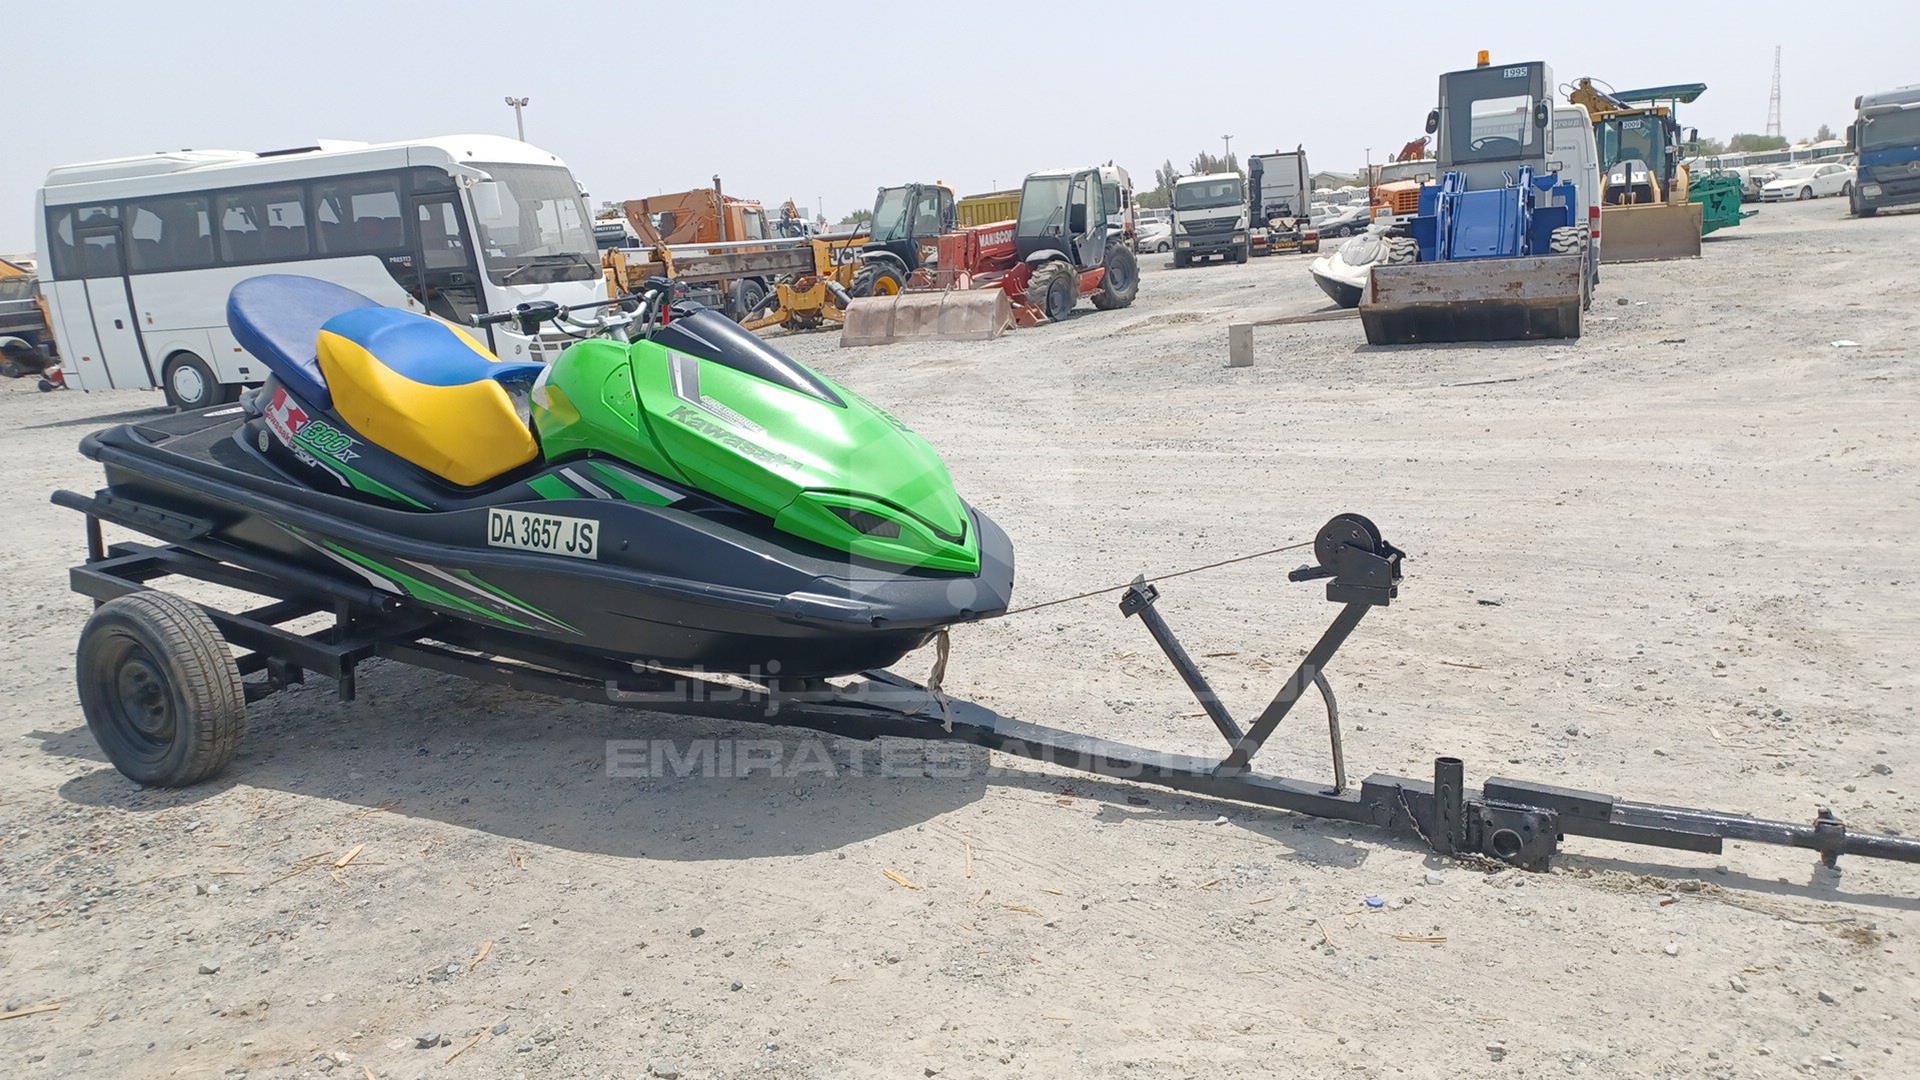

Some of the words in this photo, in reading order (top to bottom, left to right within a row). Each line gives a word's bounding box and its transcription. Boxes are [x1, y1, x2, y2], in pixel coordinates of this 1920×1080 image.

[1505, 68, 1527, 77] 1995
[491, 513, 516, 545] DA
[521, 516, 562, 550] 3657
[566, 522, 593, 554] JS
